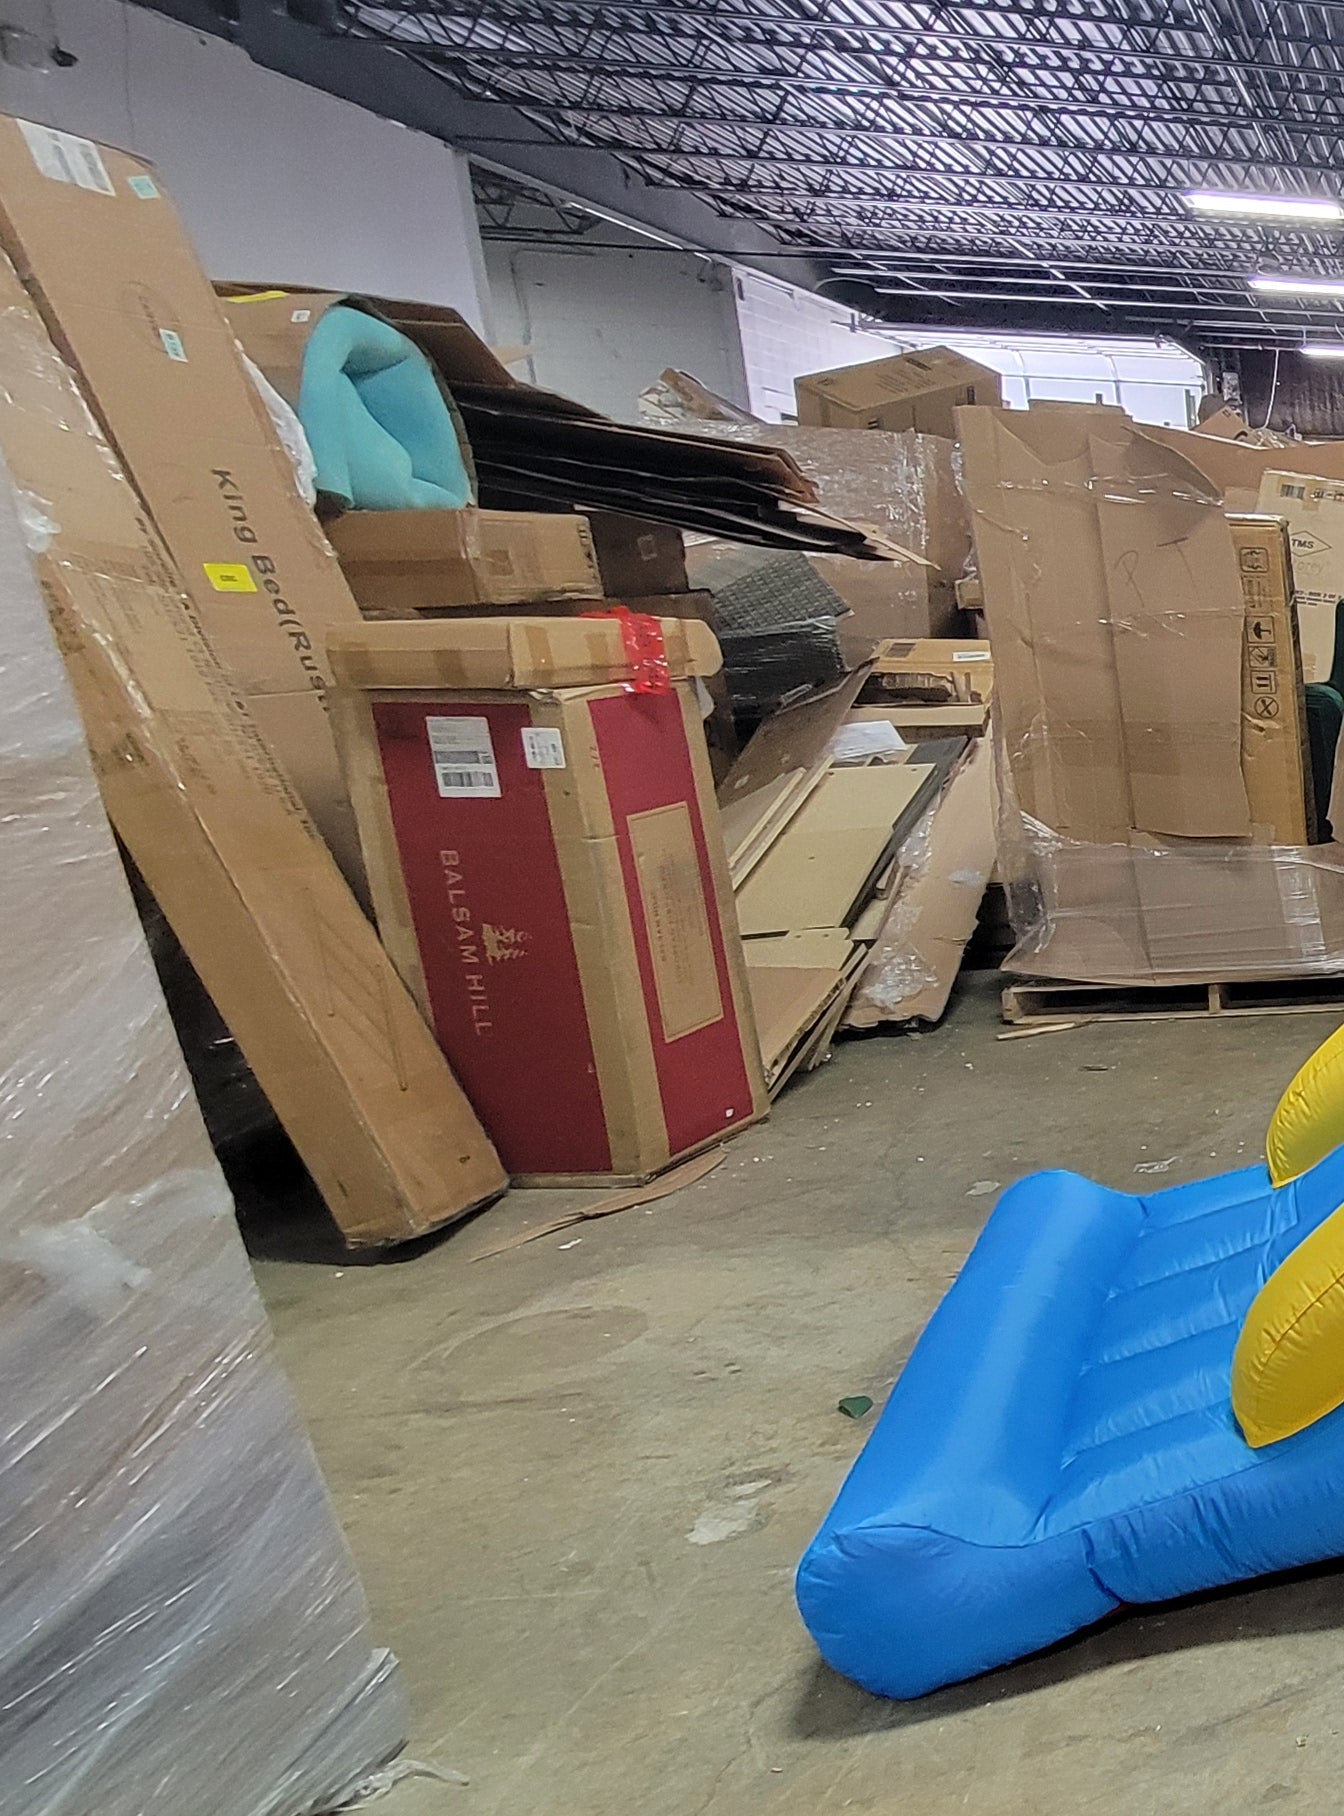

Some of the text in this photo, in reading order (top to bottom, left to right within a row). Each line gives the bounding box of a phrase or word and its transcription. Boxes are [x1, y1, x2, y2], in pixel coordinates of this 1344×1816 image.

[211, 468, 258, 544] King
[1291, 537, 1315, 550] TMS
[440, 850, 493, 1036] BALSAM HILL
